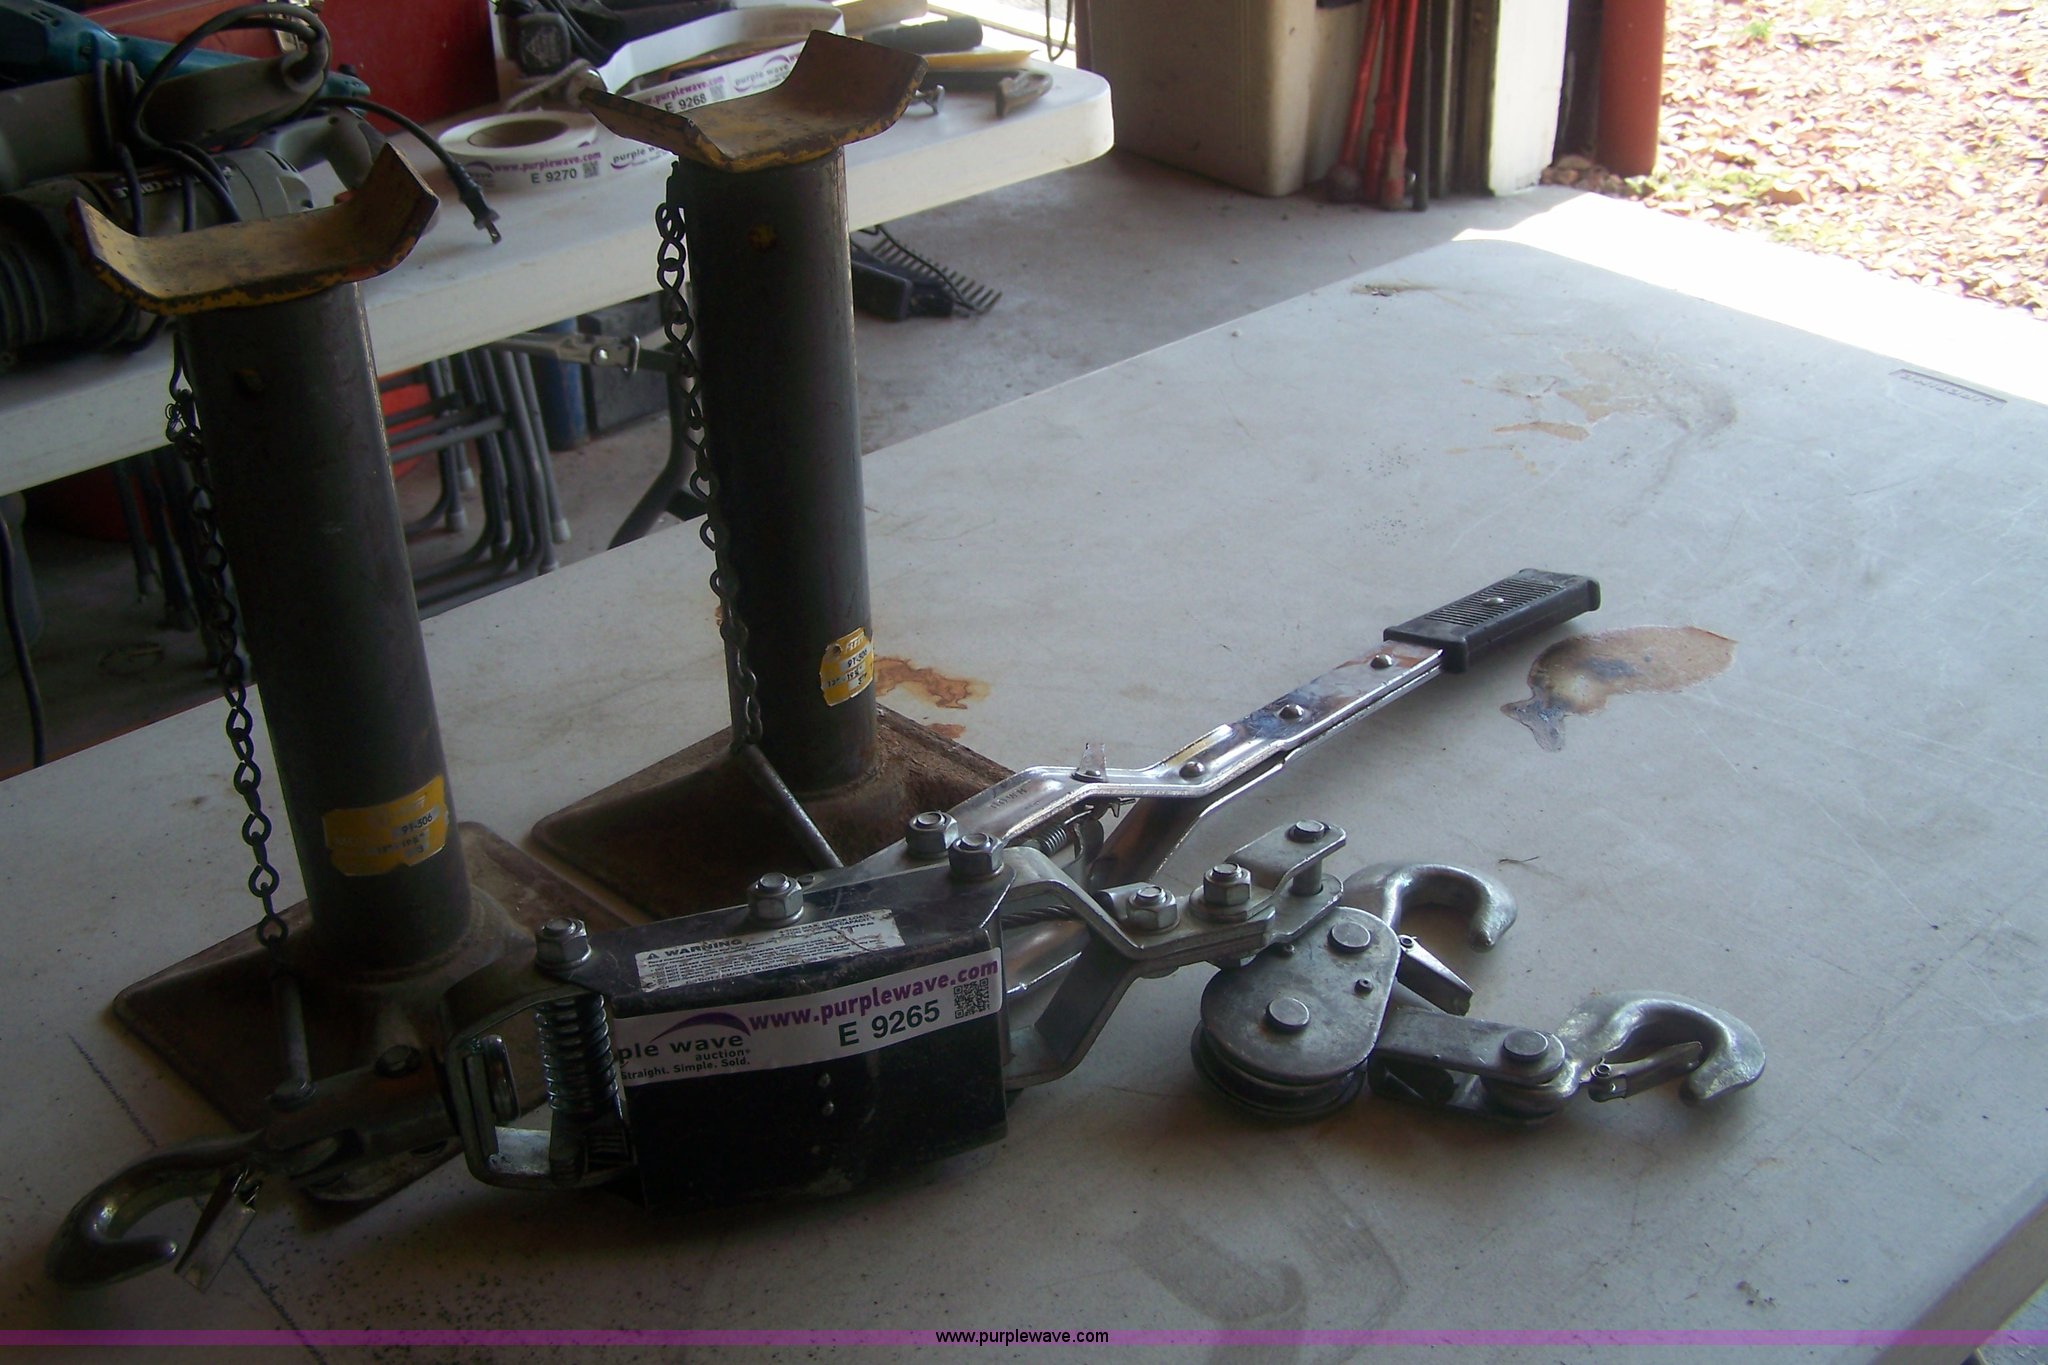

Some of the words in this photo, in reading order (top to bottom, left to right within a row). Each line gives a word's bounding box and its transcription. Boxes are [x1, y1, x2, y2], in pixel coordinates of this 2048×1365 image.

[734, 71, 764, 86] purple
[679, 93, 708, 110] 9268
[494, 151, 602, 174] www.purplewave.com
[612, 148, 646, 164] purple
[531, 173, 540, 184] E
[546, 169, 578, 184] 9270
[664, 939, 743, 957] WARNING
[748, 959, 999, 1032] www.purplewave.com
[837, 1021, 860, 1048] E
[871, 999, 941, 1040] 9265
[669, 1034, 744, 1054] wave
[695, 1048, 745, 1062] auction
[673, 1061, 718, 1074] Simple.
[720, 1057, 751, 1068] Sold.
